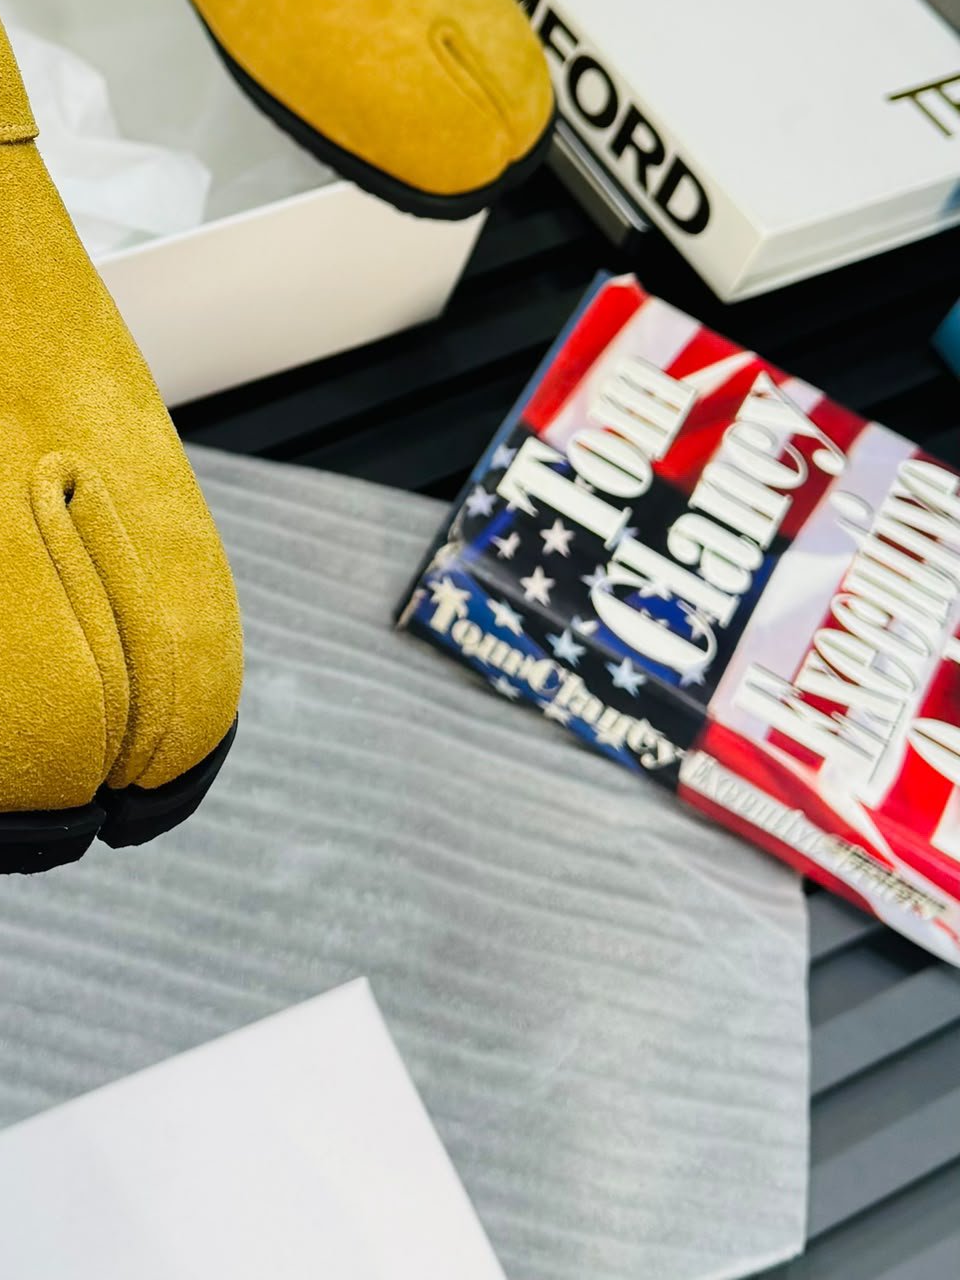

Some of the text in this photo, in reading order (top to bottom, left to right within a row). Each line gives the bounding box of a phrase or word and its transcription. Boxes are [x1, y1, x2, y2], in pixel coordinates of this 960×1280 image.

[496, 354, 697, 550] Tom
[590, 370, 848, 671] Clancy
[528, 657, 680, 769] Clancy
